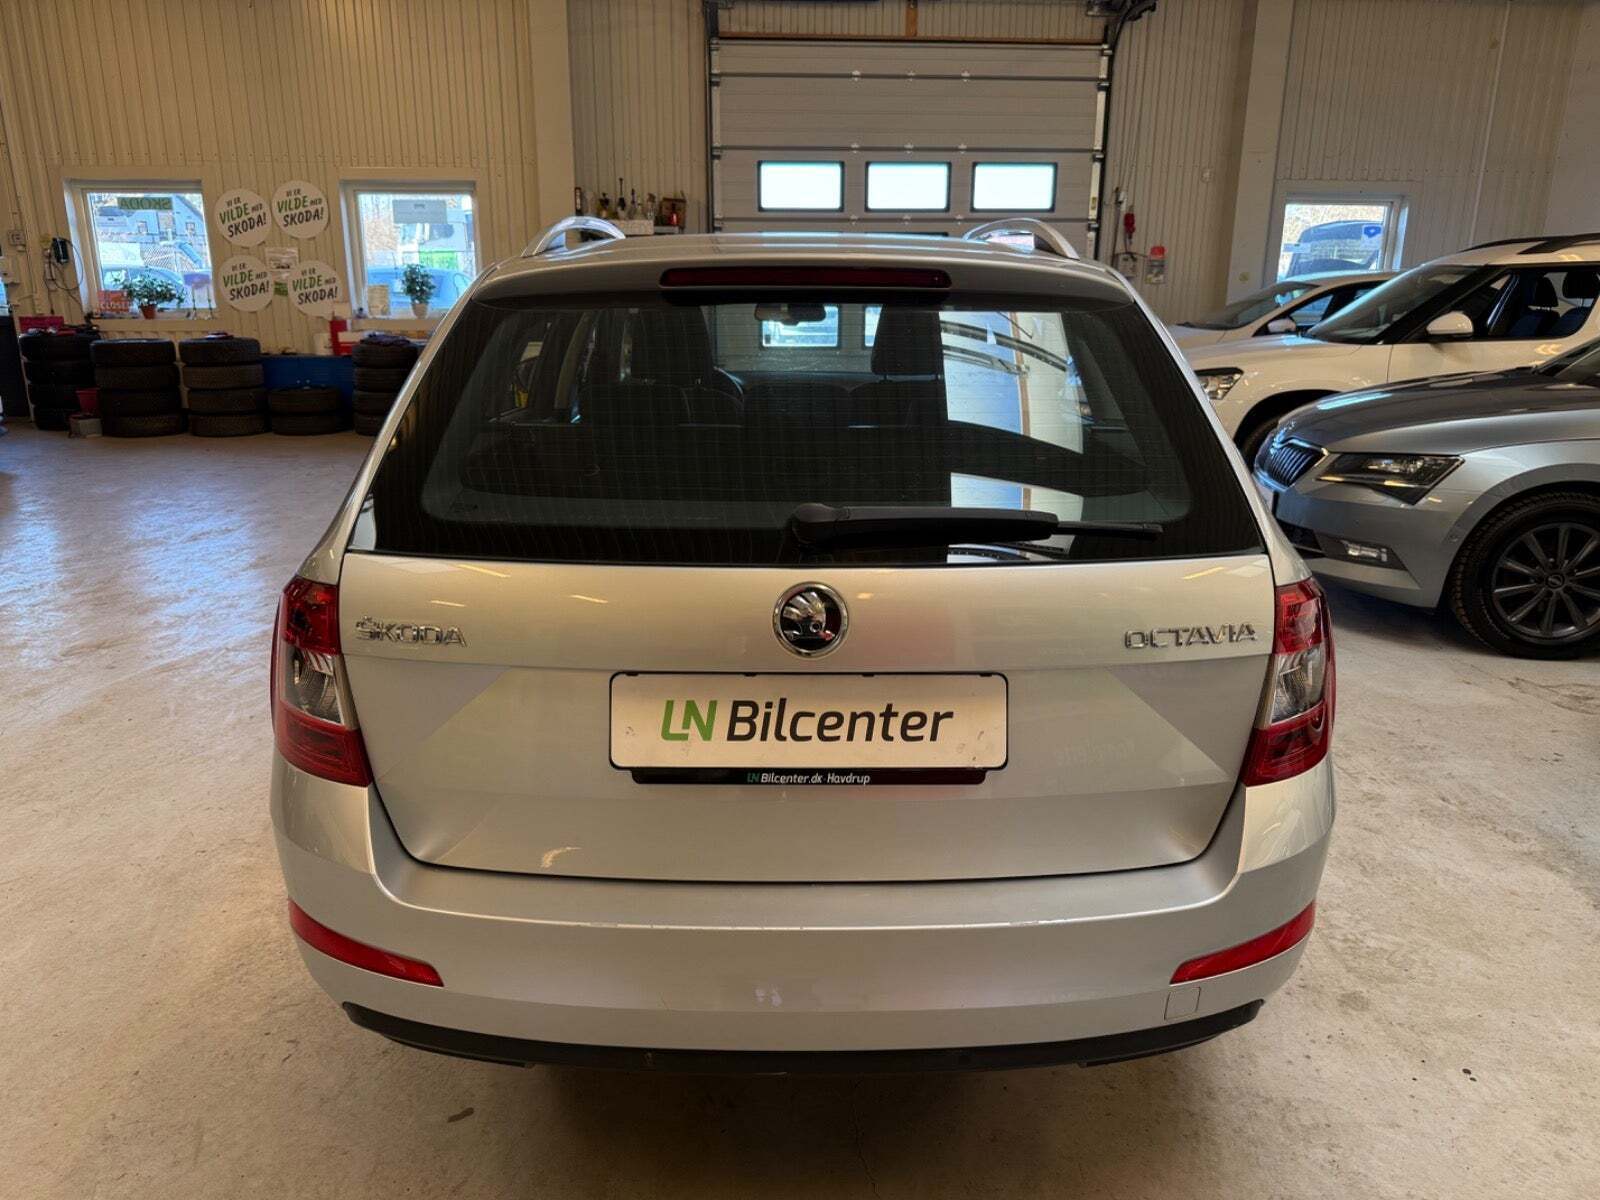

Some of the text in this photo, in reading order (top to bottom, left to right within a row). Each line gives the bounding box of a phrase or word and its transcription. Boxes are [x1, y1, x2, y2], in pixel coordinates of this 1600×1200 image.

[219, 202, 249, 225] VILDE
[277, 195, 309, 214] VILDE
[227, 212, 267, 238] SKODA!
[283, 206, 324, 228] SKODA!
[222, 269, 253, 288] VILDE
[292, 274, 323, 293] VILDE
[229, 280, 270, 301] SKODA!
[298, 286, 338, 305] SKODA!
[1124, 621, 1257, 650] OCTAVIA
[660, 697, 954, 743] LN Bilcenter
[761, 772, 823, 784] Bilcenter.dk
[826, 772, 871, 786] Havdrup
